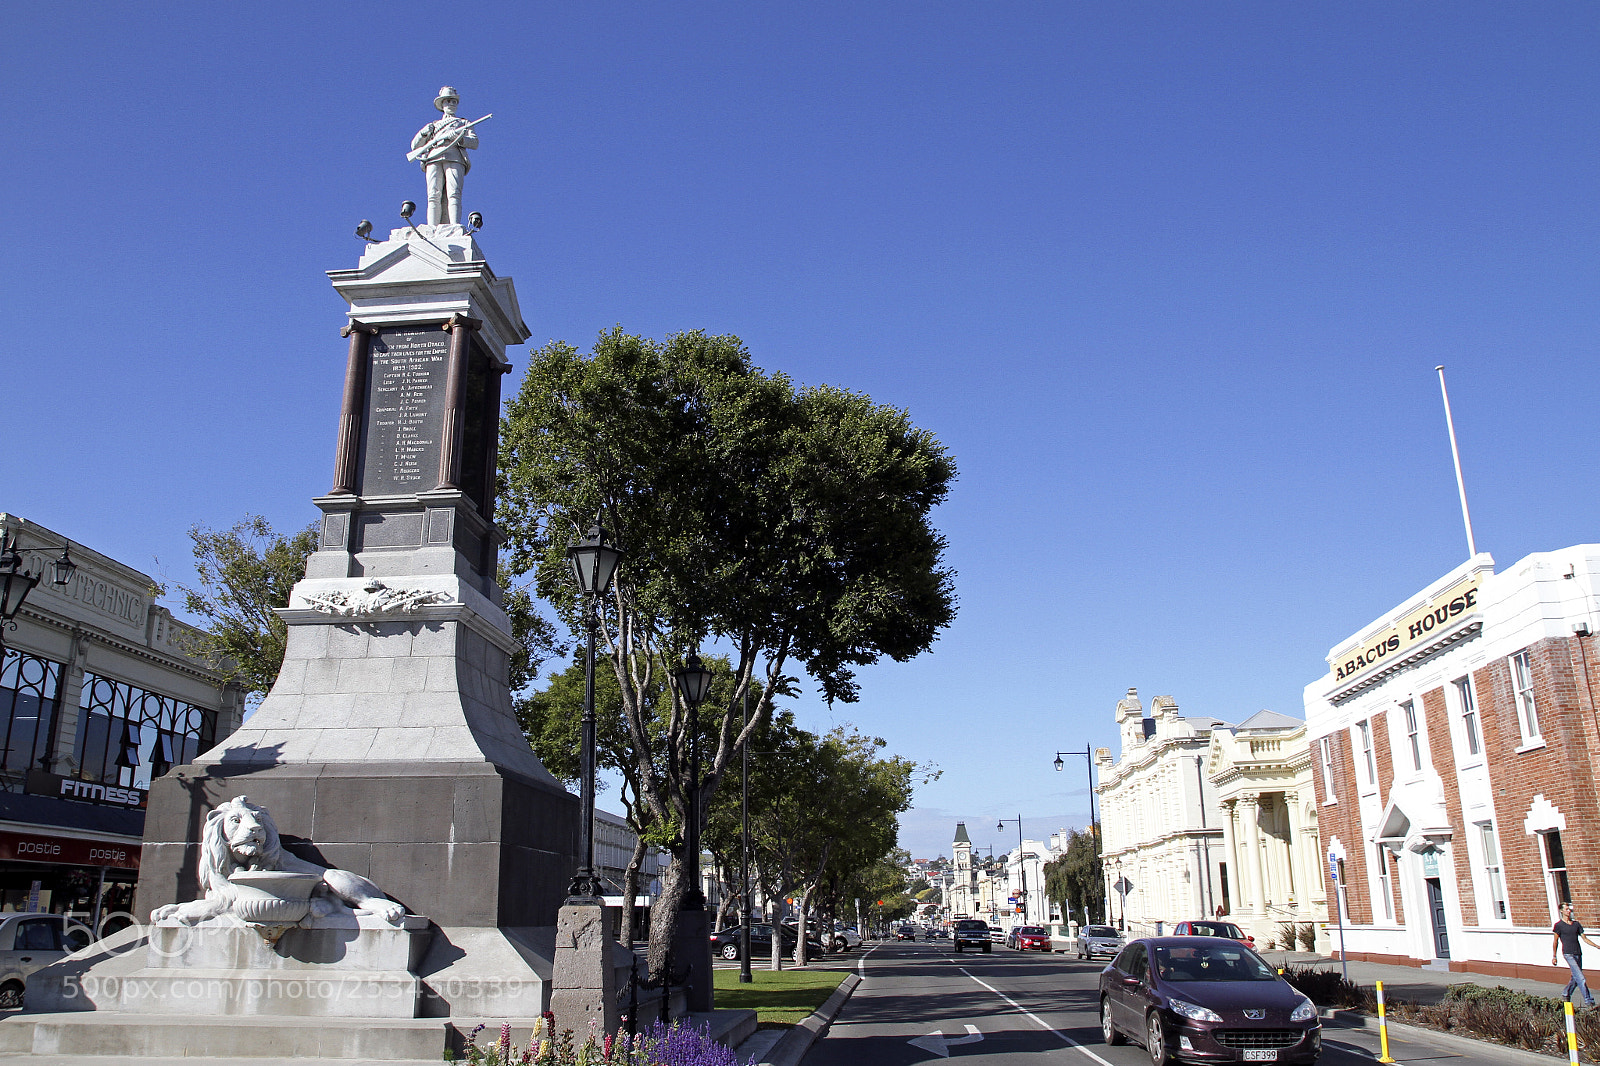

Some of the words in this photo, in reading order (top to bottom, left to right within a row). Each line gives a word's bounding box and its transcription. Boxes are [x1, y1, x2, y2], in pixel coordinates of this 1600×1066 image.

[1335, 634, 1400, 681] ABACUS
[1408, 587, 1478, 640] HOUSE
[60, 778, 140, 806] FITNESS
[17, 841, 61, 855] postie
[89, 847, 126, 861] postie
[1245, 1050, 1276, 1060] CSF399
